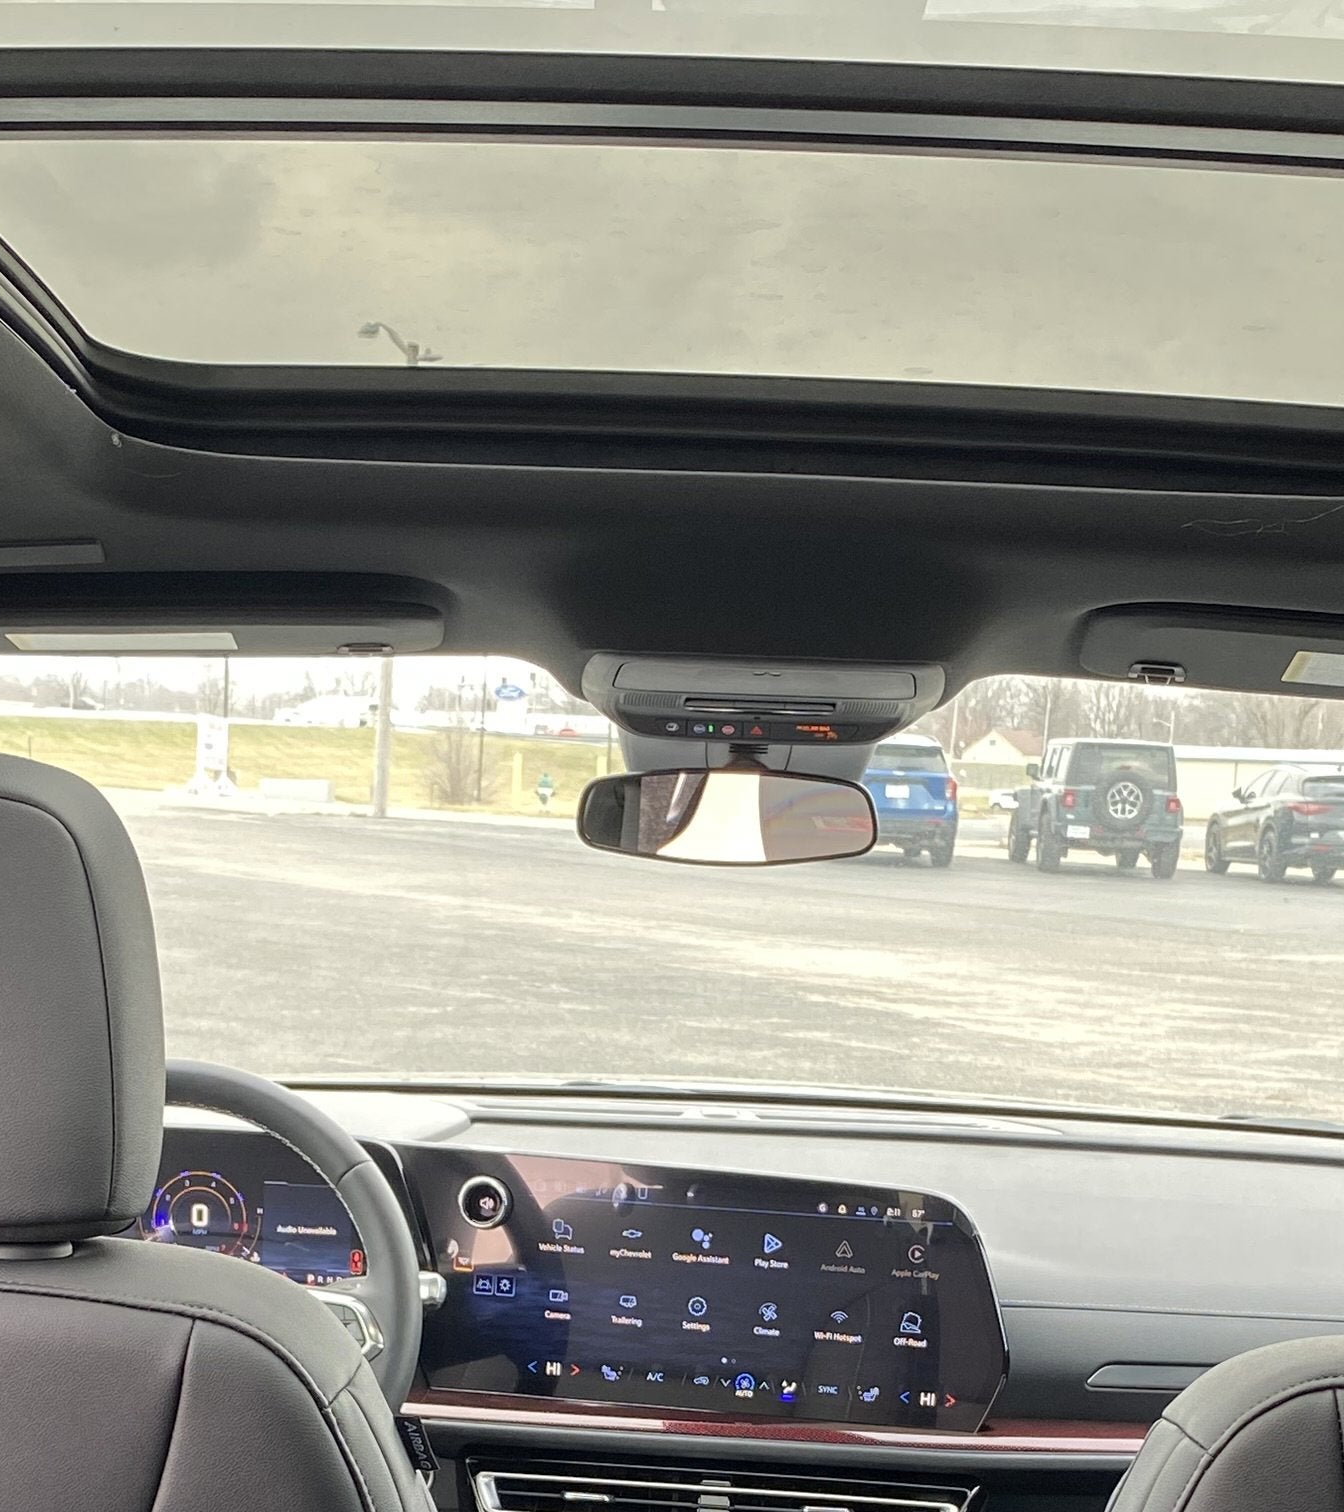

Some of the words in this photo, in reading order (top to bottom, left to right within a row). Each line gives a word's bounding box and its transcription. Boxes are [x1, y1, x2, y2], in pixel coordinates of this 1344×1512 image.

[191, 1203, 208, 1227] 0
[538, 1242, 562, 1253] Vehicle
[563, 1244, 585, 1254] Status
[672, 1252, 697, 1263] Google
[697, 1254, 730, 1265] Assistant
[754, 1258, 769, 1269] Play
[770, 1259, 789, 1269] Store
[820, 1264, 848, 1273] Android
[848, 1265, 866, 1274] Auto
[891, 1269, 912, 1278] Apple
[912, 1270, 940, 1281] CarPlay
[544, 1310, 571, 1320] Camera
[682, 1321, 710, 1332] Settings
[753, 1326, 780, 1337] Climate
[814, 1331, 833, 1340] Wi-Fi
[833, 1333, 862, 1344] Hotspot
[893, 1337, 927, 1348] Off-Road
[545, 1361, 562, 1376] HI
[646, 1372, 664, 1382] A/C
[735, 1389, 754, 1398] AUTO
[817, 1385, 838, 1395] SYNC
[919, 1391, 936, 1407] HI
[404, 1421, 432, 1469] AIRBAG
